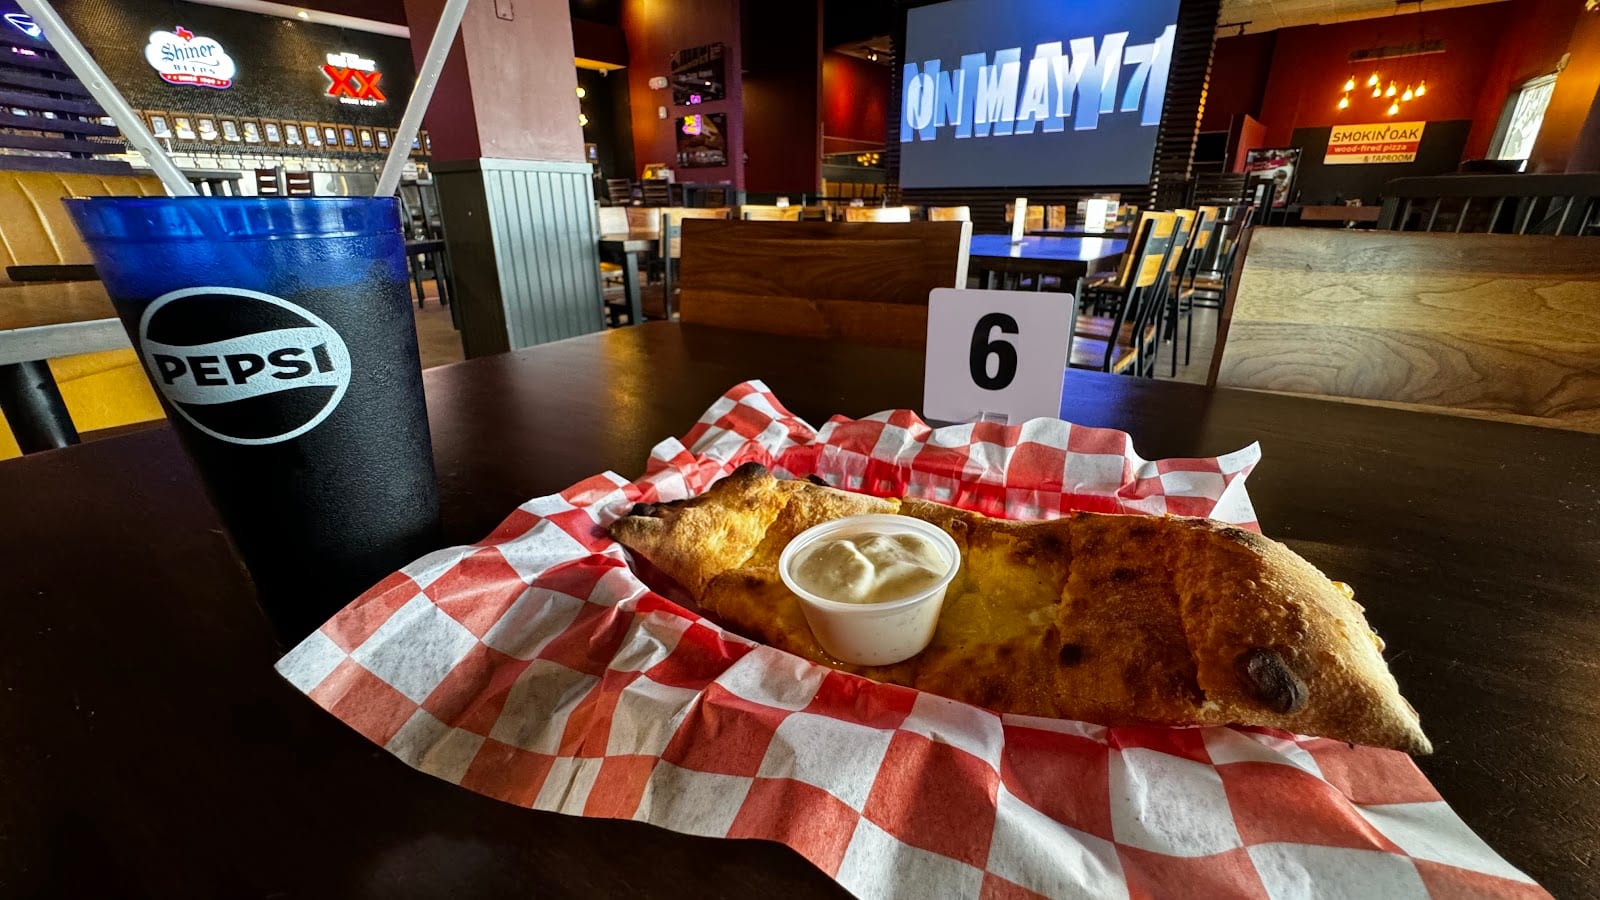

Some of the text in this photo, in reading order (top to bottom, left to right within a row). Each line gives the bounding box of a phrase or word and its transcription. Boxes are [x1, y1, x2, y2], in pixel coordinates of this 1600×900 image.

[161, 43, 216, 62] Shiner
[319, 64, 387, 103] XX
[955, 31, 1129, 138] MAY
[1334, 143, 1407, 153] wood-fired pizza
[1372, 154, 1413, 162] TAPROOM
[152, 342, 336, 386] PEPSI
[969, 312, 1019, 391] 6
